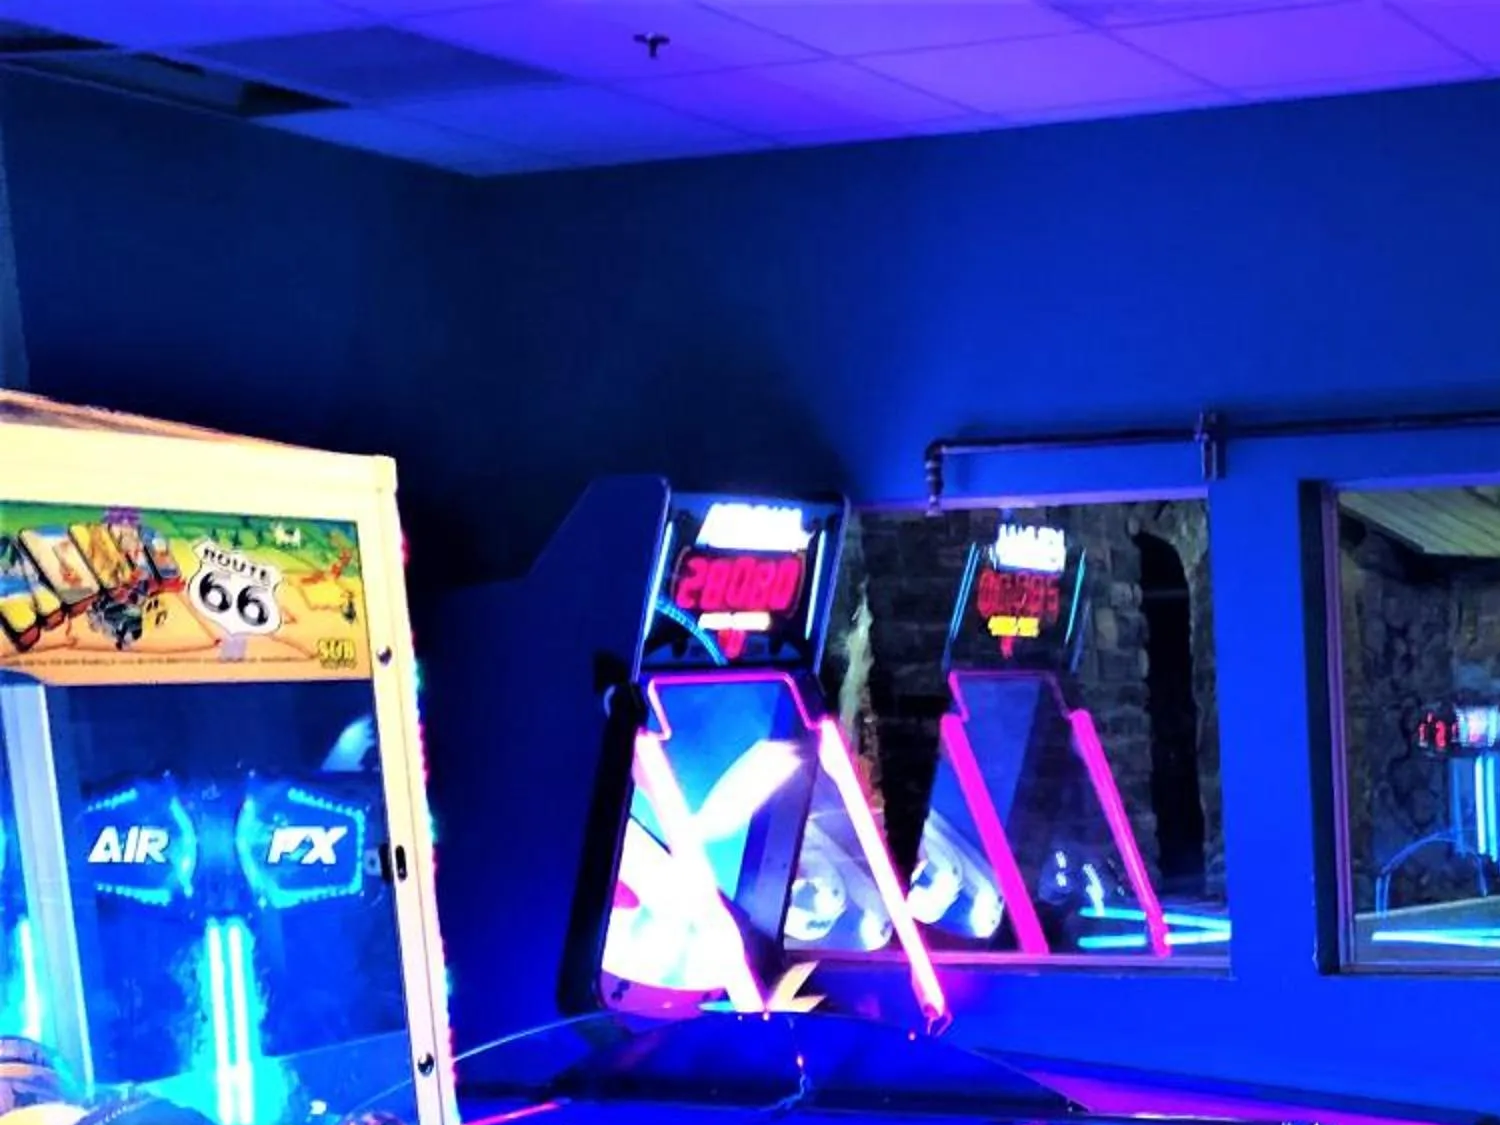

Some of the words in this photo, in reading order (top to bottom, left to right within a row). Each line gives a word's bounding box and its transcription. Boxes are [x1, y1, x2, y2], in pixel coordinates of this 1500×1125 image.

[203, 547, 272, 584] ROUTE
[199, 570, 270, 627] 66
[88, 825, 170, 864] AIR
[266, 825, 348, 866] FX
